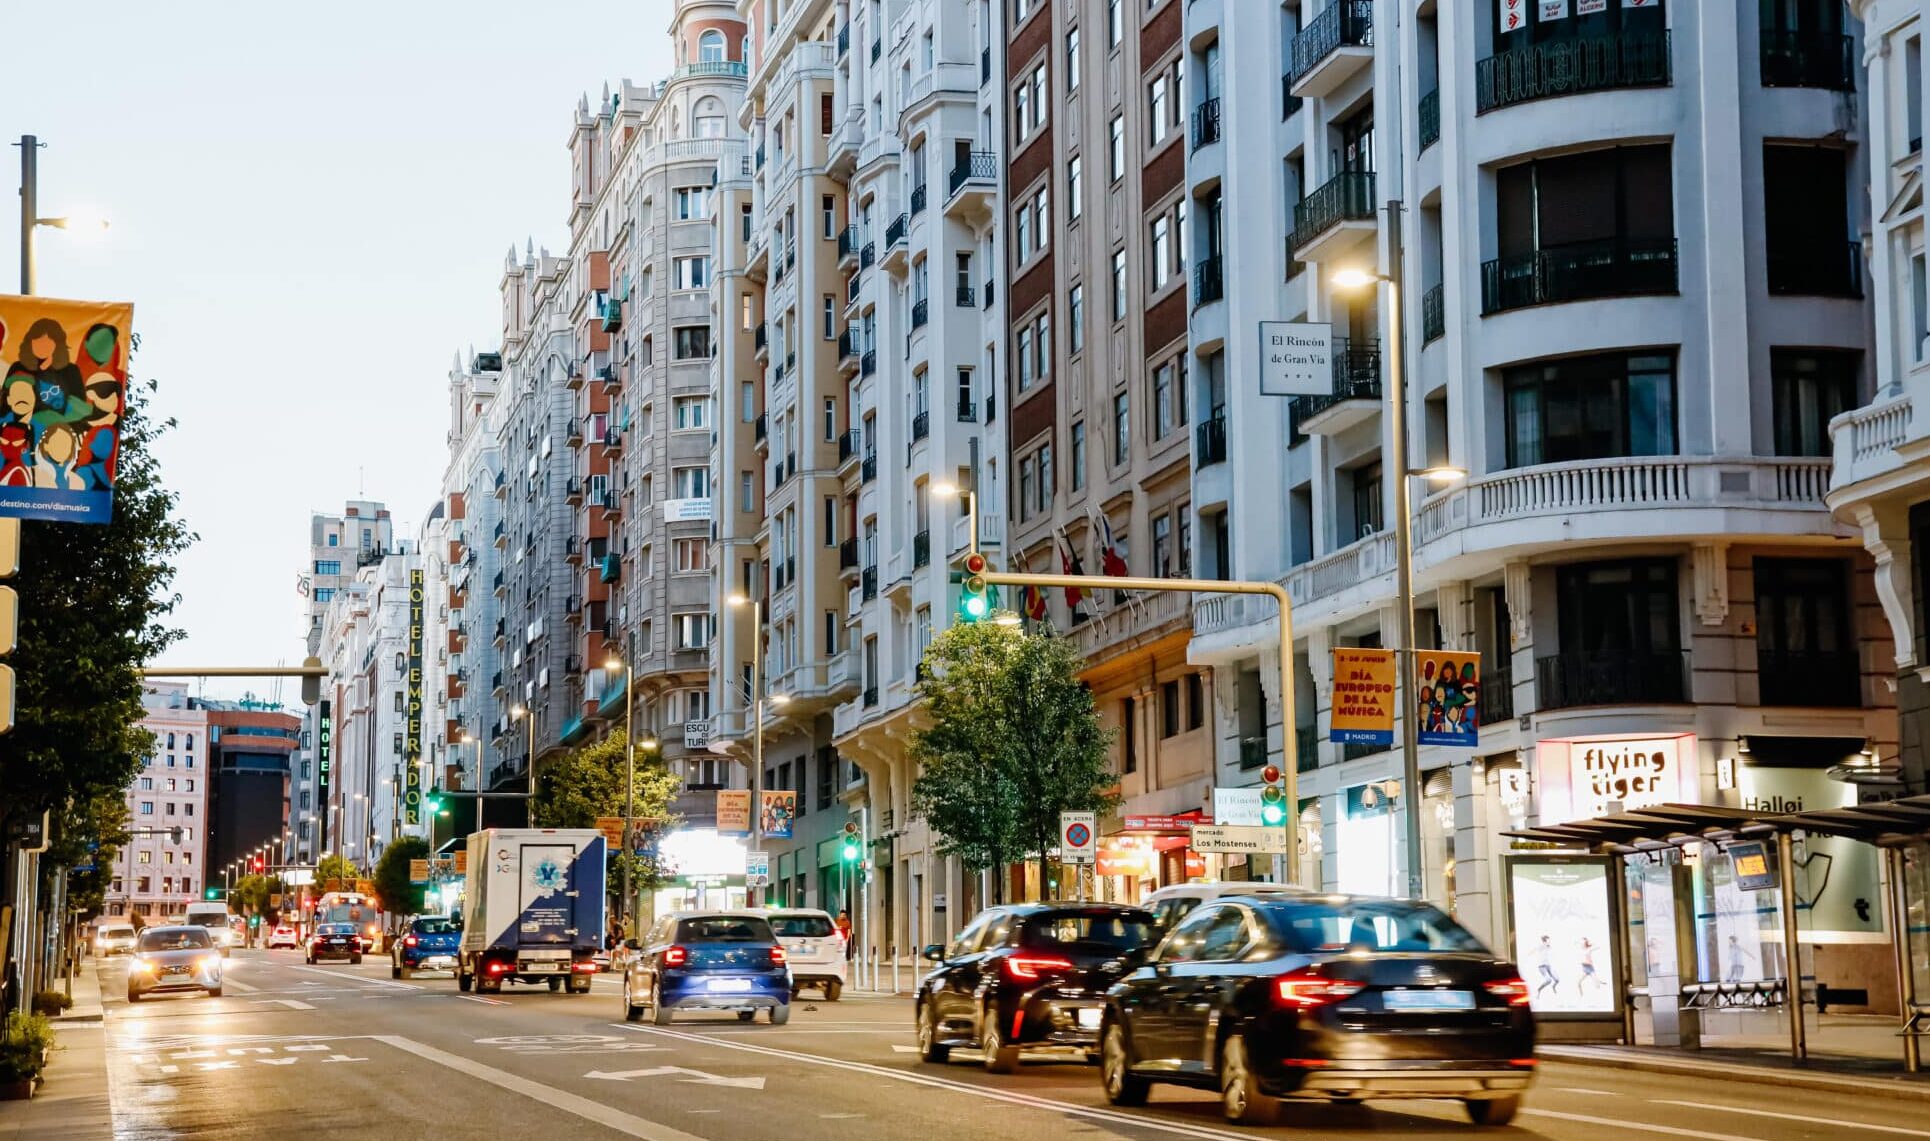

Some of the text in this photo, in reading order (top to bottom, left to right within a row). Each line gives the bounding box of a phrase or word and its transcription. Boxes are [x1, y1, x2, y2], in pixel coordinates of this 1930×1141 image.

[1271, 335, 1325, 347] El Rincón
[1271, 353, 1282, 363] de
[1284, 354, 1307, 364] Gran
[1350, 668, 1373, 680] DÍA
[1335, 683, 1392, 693] EUROPEO
[406, 569, 424, 824] HOTEL EMPERADOR
[1344, 694, 1379, 704] DE LA
[1338, 704, 1385, 716] MÚSICA
[320, 717, 330, 786] HOTEL
[1584, 747, 1665, 774] flying
[1591, 773, 1661, 799] tiger
[1196, 839, 1257, 848] Los Mostenses
